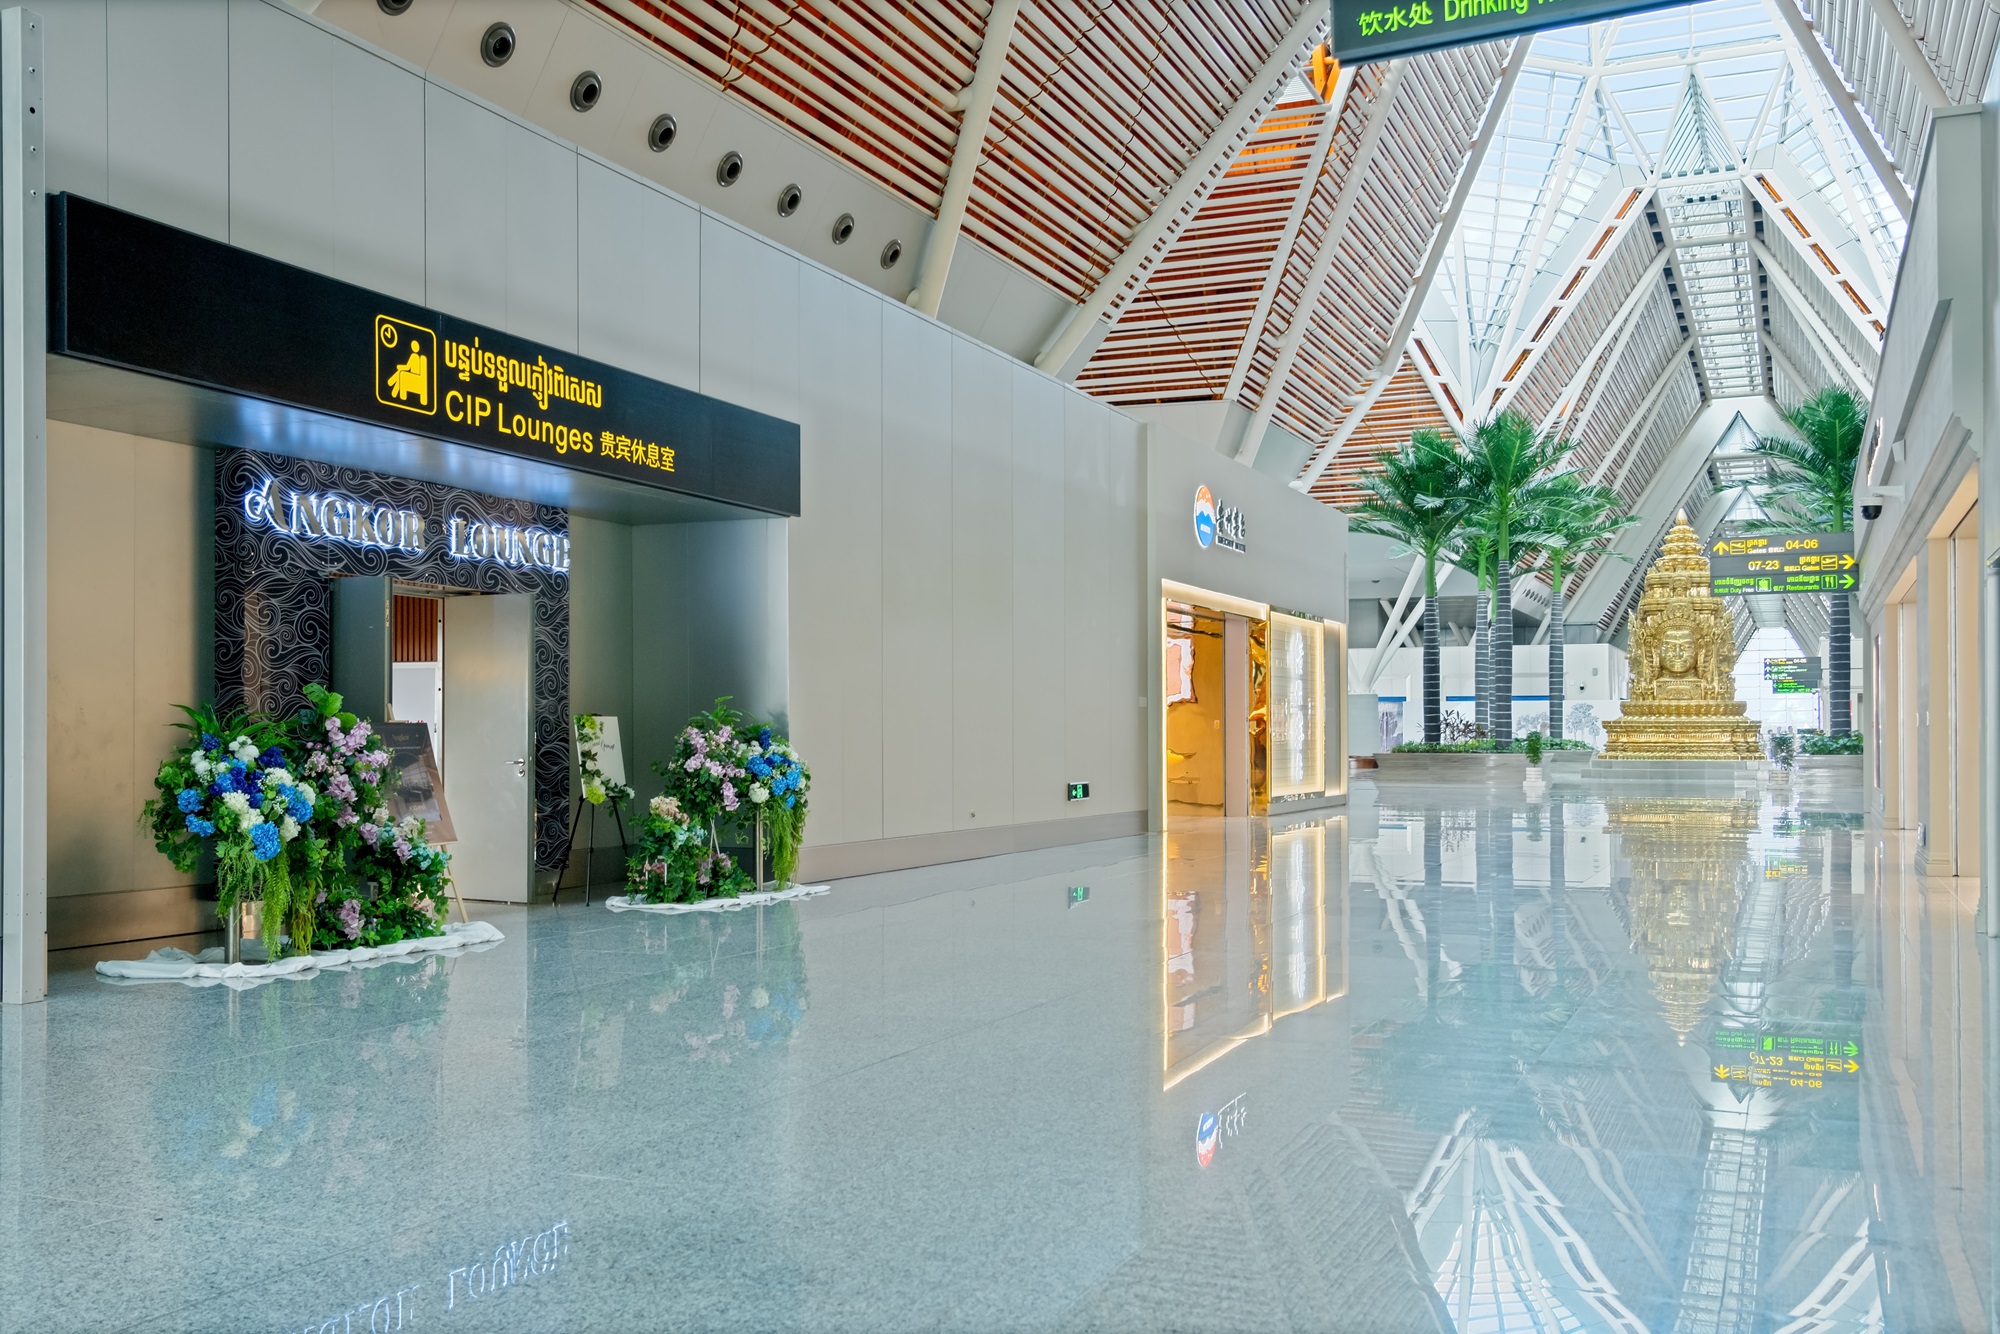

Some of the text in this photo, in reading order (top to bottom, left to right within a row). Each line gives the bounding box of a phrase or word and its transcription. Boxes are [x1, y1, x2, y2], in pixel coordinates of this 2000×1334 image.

[1359, 6, 1433, 37] 饮水处
[445, 390, 675, 473] CIP Lounges 贵宾休息室
[244, 478, 572, 571] ANGKOR LOUNGE
[1785, 539, 1819, 550] 04-06
[1748, 560, 1780, 571] 07-23
